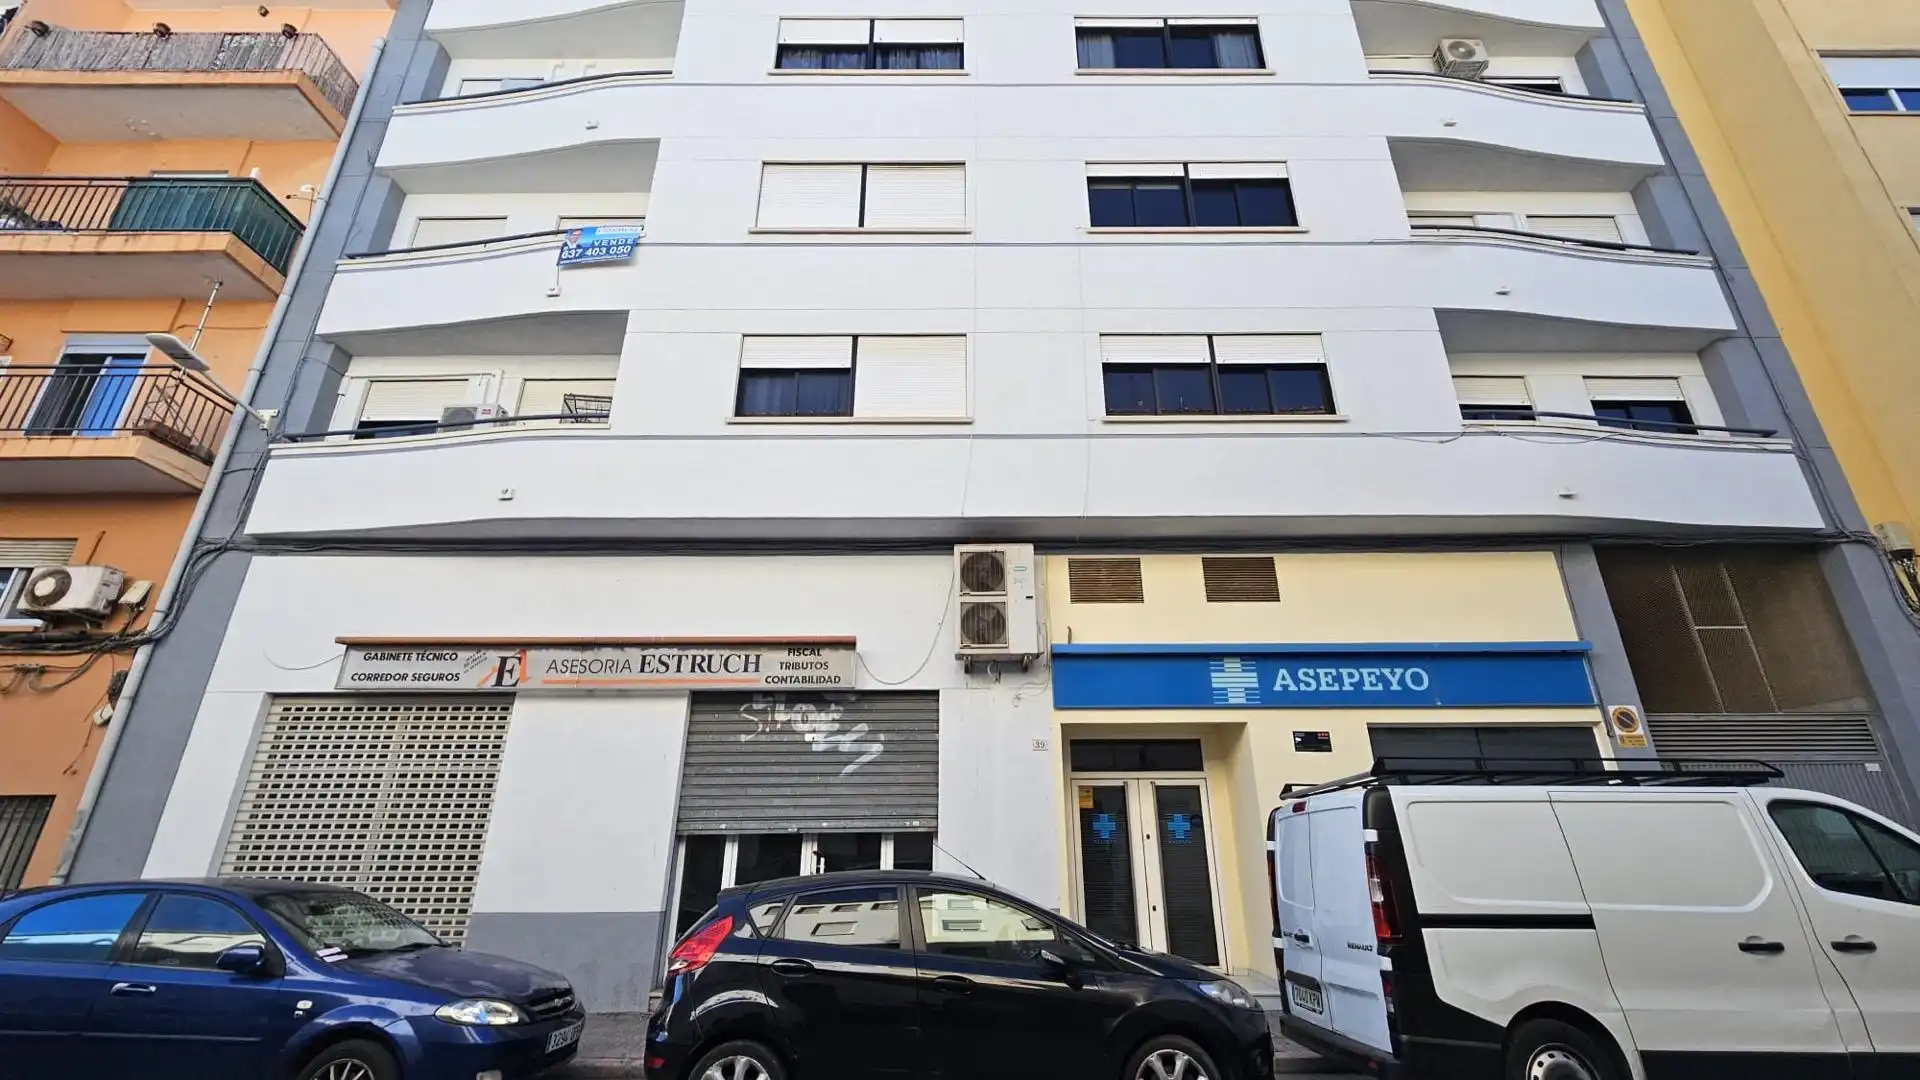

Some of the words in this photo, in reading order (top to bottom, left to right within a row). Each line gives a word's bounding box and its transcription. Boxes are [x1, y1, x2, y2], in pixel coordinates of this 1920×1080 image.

[594, 238, 634, 246] VENDE
[562, 249, 582, 259] 637
[585, 246, 607, 256] 403
[610, 245, 631, 254] 050
[363, 652, 414, 662] GABINETE
[415, 649, 458, 662] TÉCNICO
[787, 648, 823, 657] FISCAL
[546, 658, 633, 674] ASESORIA
[638, 653, 763, 674] ESTRUCH
[779, 661, 829, 670] TRIBUTOS
[350, 672, 409, 682] CORREDOR
[410, 672, 461, 682] SEGUROS
[764, 675, 842, 684] CONTABILIDAD
[1273, 667, 1430, 691] ASEPEYO
